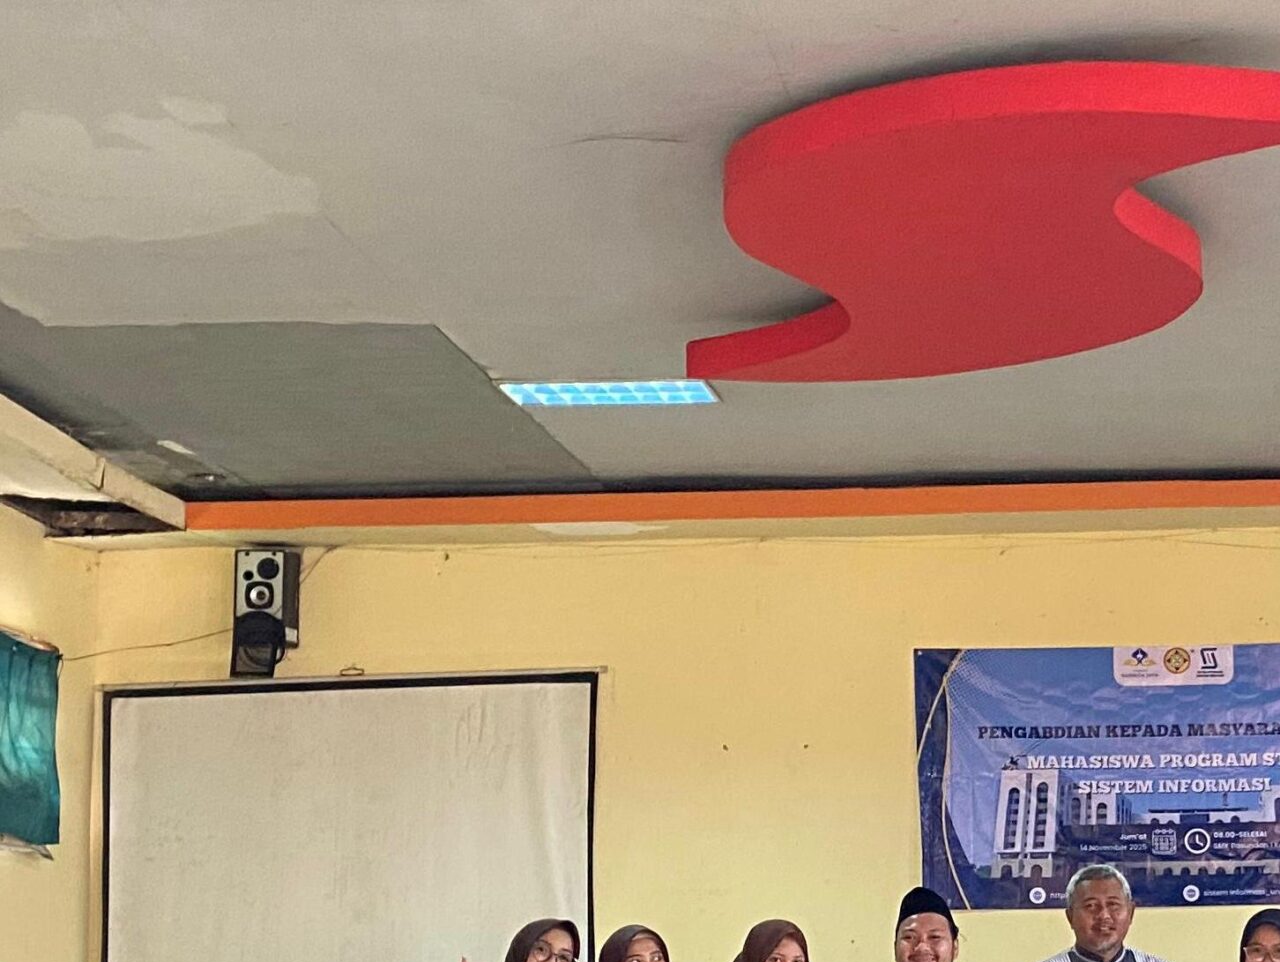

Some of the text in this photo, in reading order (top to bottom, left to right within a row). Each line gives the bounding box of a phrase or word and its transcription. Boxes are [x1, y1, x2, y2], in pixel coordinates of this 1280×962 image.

[978, 725, 1101, 740] PENGABDIAN
[1105, 724, 1183, 738] KEPADA
[1027, 754, 1156, 769] MAHASISWA
[1159, 752, 1258, 768] PROGRAM
[1078, 777, 1272, 794] SISTEM INFORMASI
